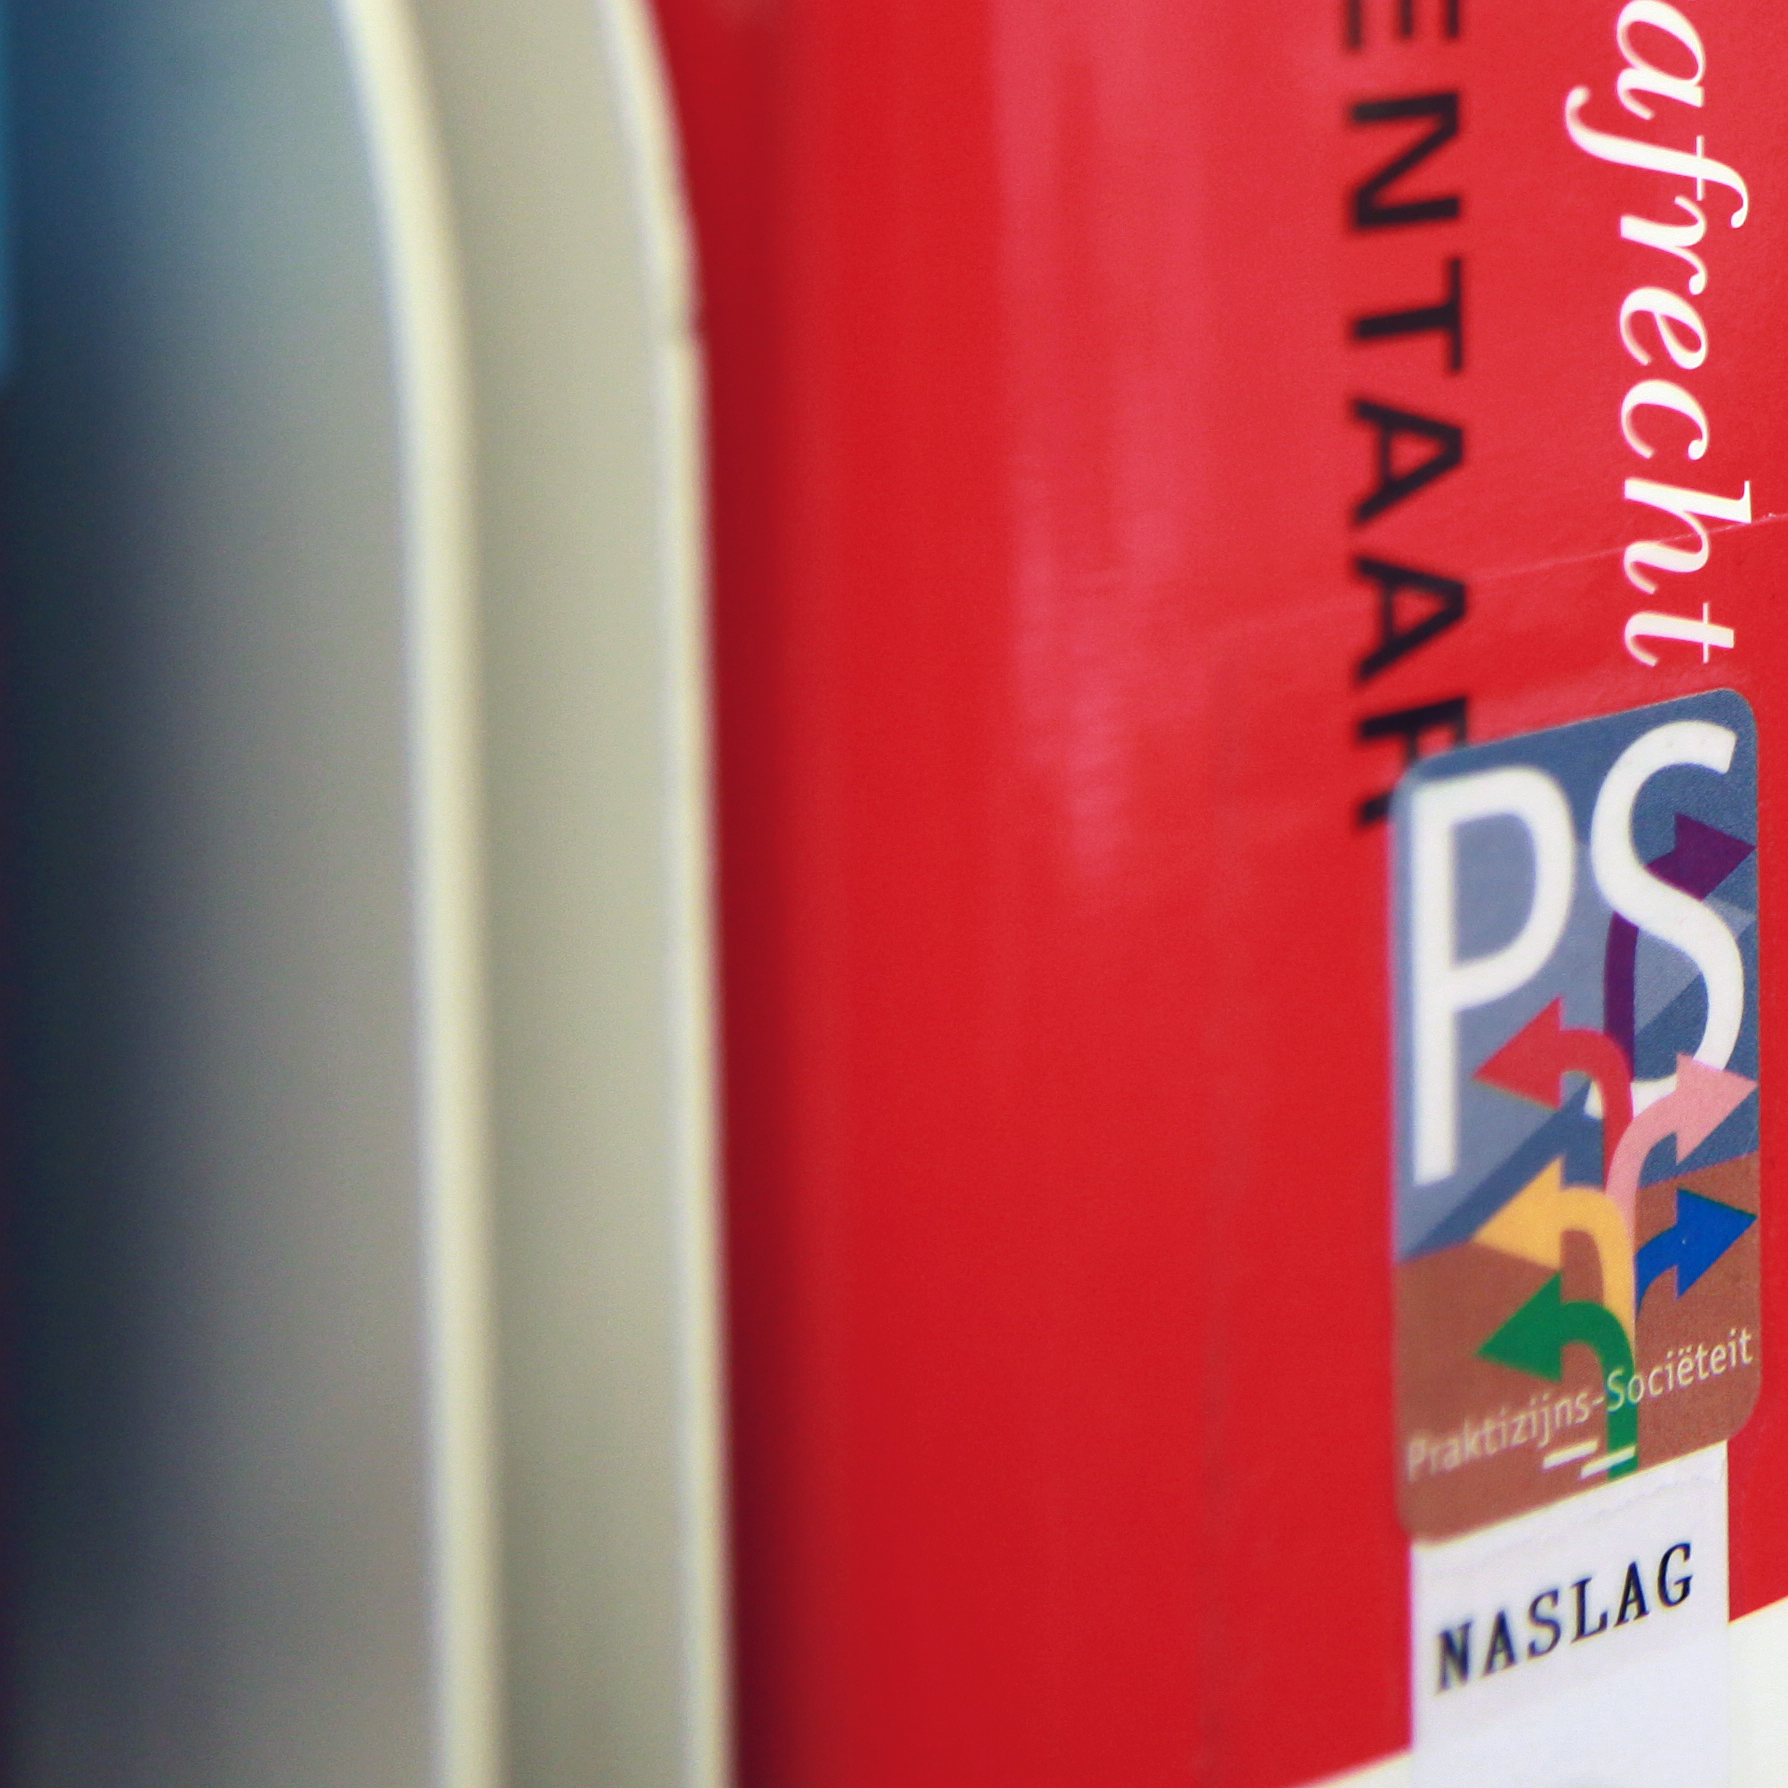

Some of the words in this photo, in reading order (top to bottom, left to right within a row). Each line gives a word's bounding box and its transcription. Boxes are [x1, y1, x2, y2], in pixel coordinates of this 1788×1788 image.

[1410, 719, 1745, 1188] PS
[1405, 1326, 1755, 1483] Praktizijns-Sociëteit
[1434, 1541, 1694, 1696] NASLAG
